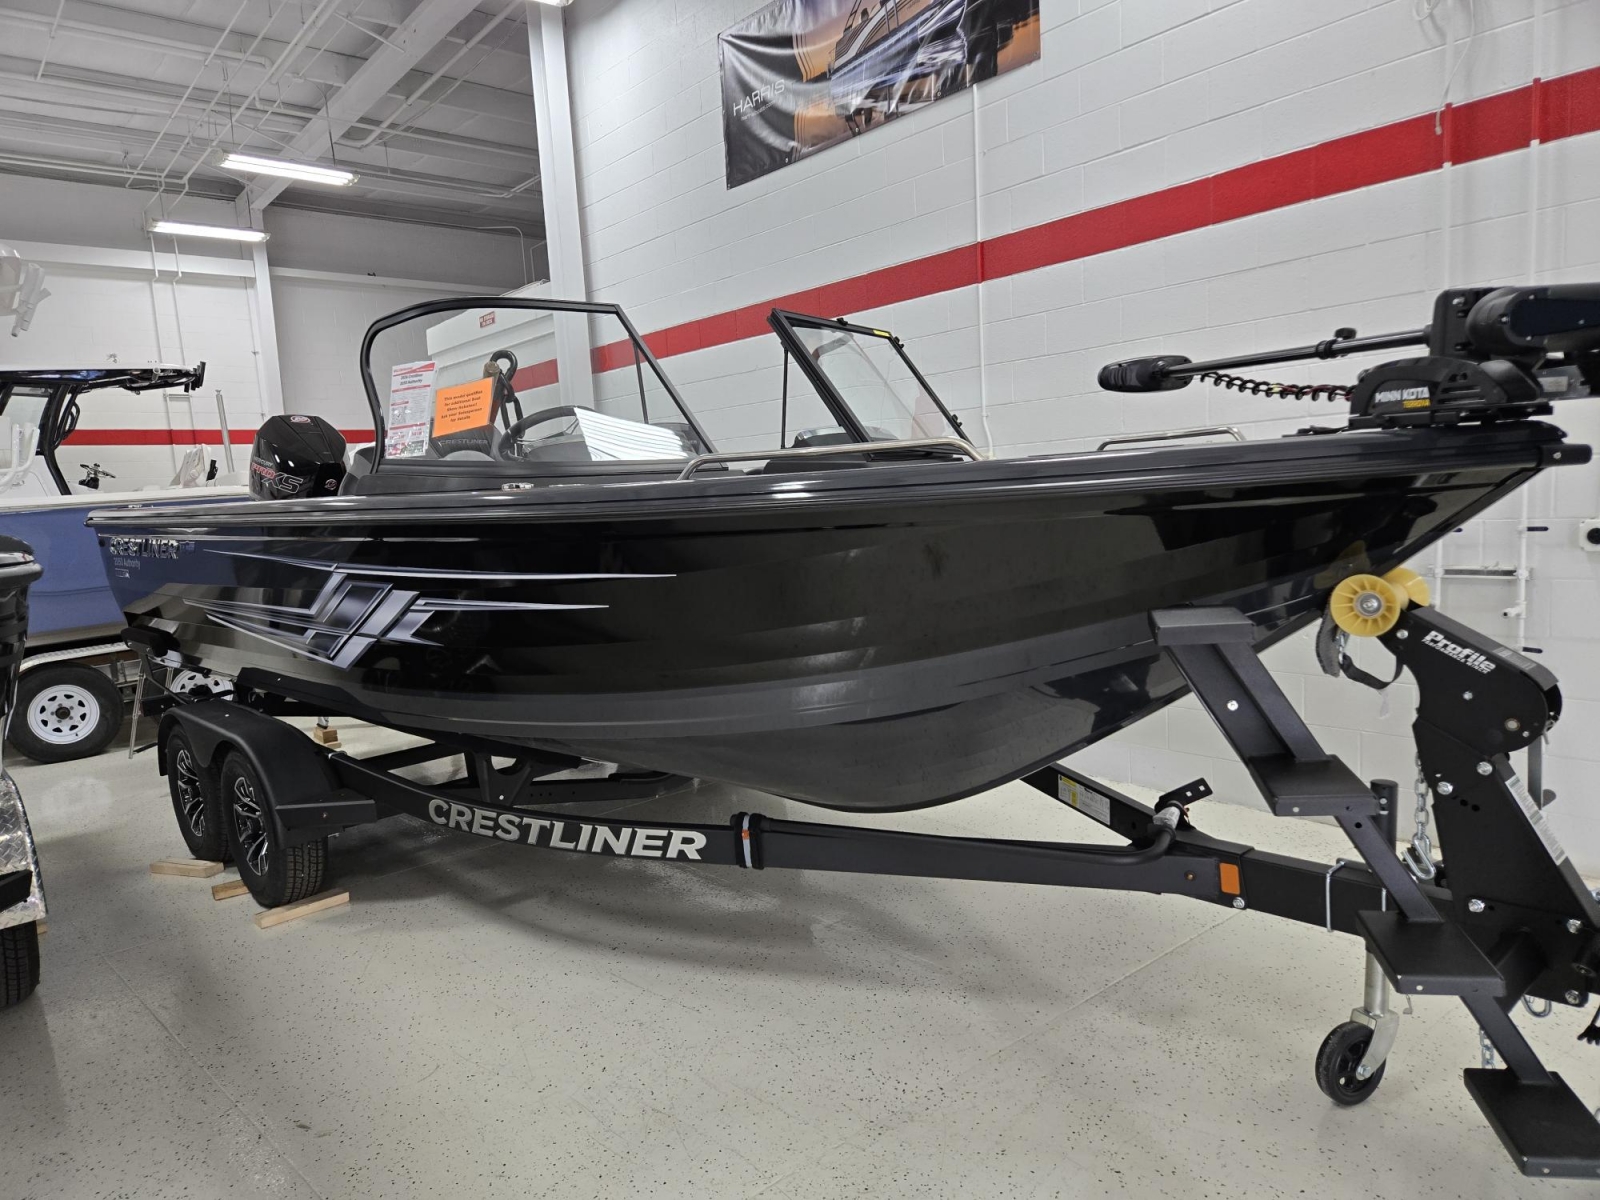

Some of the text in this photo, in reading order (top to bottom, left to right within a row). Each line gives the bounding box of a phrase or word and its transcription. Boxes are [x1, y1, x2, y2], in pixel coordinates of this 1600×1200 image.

[733, 79, 785, 116] HARRIS
[451, 398, 470, 406] additional
[1375, 386, 1430, 403] MINN KOTA
[261, 472, 304, 494] XS
[109, 537, 179, 559] CRESTLINER
[124, 558, 141, 570] Authority
[1424, 630, 1497, 670] Profile
[428, 799, 707, 860] CRESTLINER
